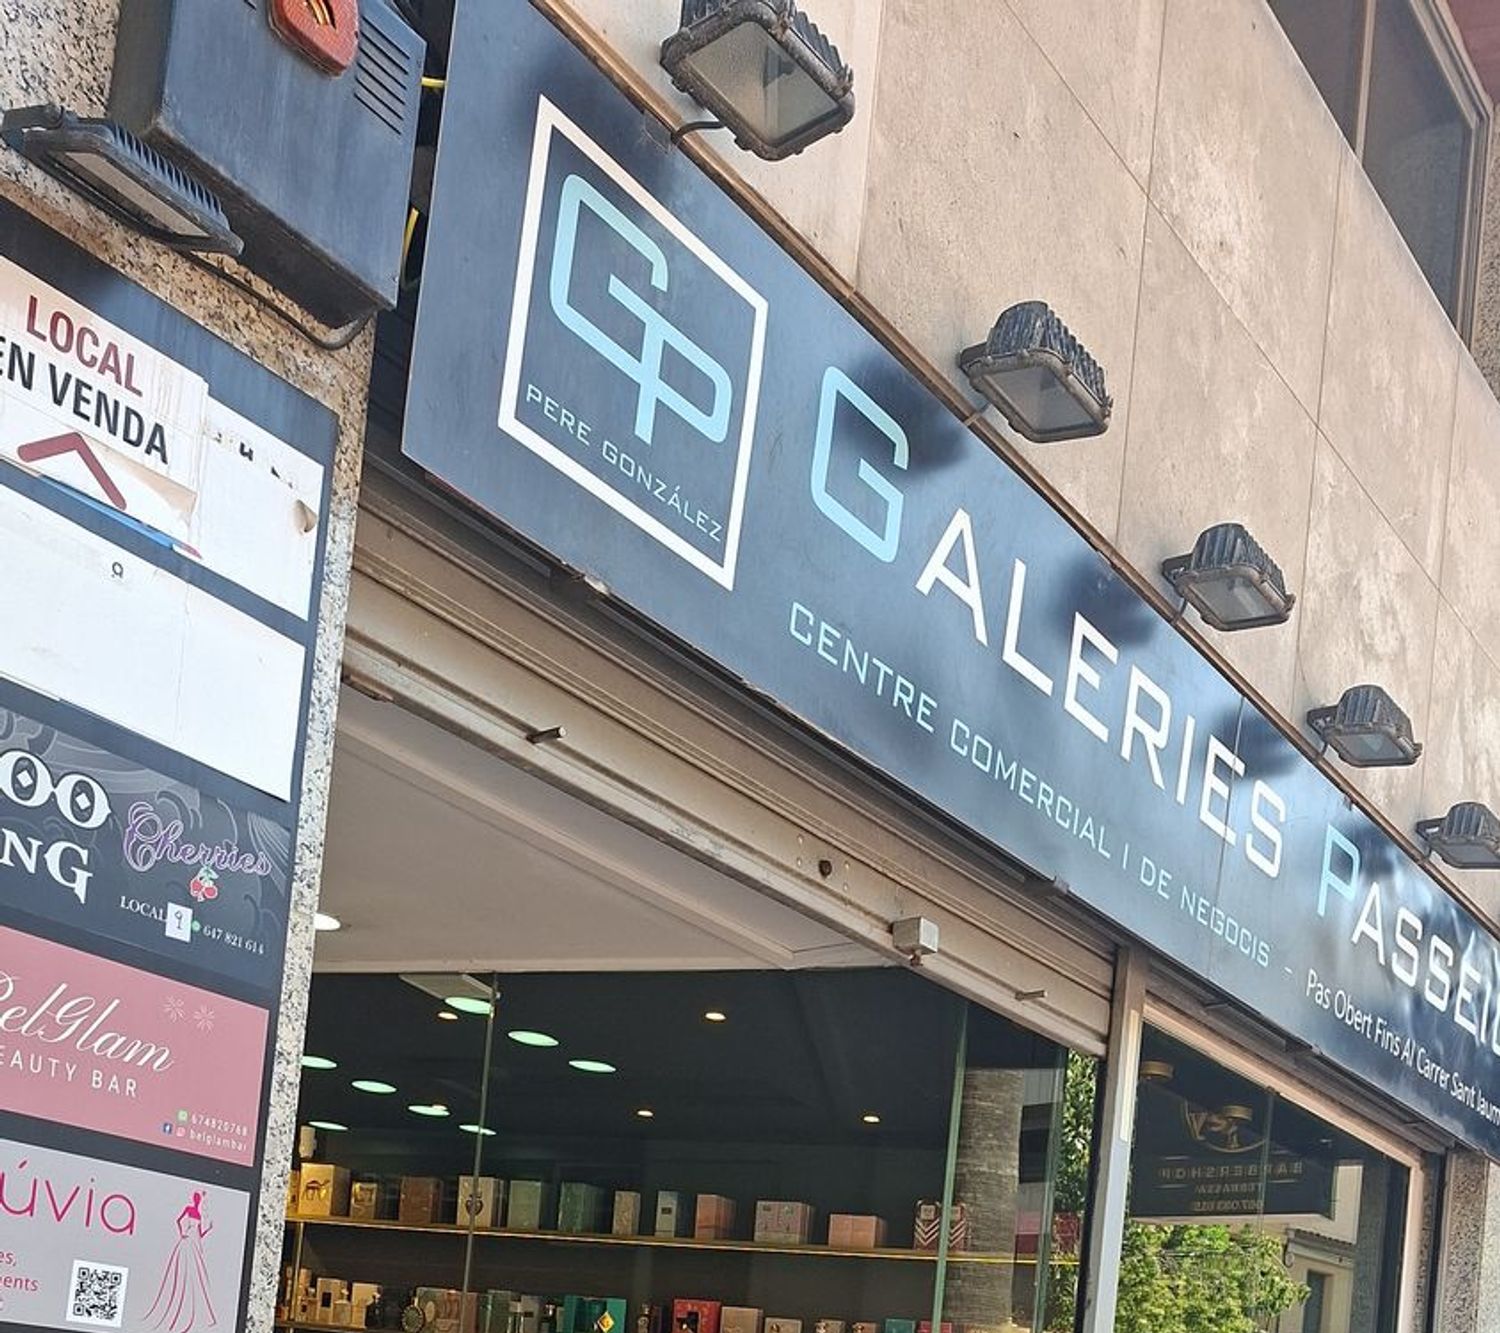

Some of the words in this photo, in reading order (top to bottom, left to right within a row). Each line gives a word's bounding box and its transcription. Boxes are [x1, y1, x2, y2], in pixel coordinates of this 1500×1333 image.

[26, 295, 143, 398] LOCAL
[48, 362, 169, 465] VENDA
[527, 384, 592, 446] PERE
[602, 440, 724, 542] GONZÁLEZ
[811, 366, 1287, 878] GALERIES
[0, 828, 93, 904] NG
[122, 801, 272, 876] Cherries
[790, 601, 938, 733] CENTRE
[951, 719, 1111, 859] COMERCIAL
[1122, 843, 1130, 870] I
[1140, 856, 1173, 899] DE
[1181, 886, 1271, 967] NEGOCIS
[1306, 968, 1331, 1009] Pas
[1334, 990, 1373, 1040] Obert
[1374, 1017, 1400, 1056] Fins
[1401, 1037, 1416, 1067] Al
[1416, 1047, 1450, 1090] Carrer
[1450, 1072, 1476, 1109] Sant
[120, 896, 167, 922] LOCAL
[91, 1070, 137, 1097] BAR
